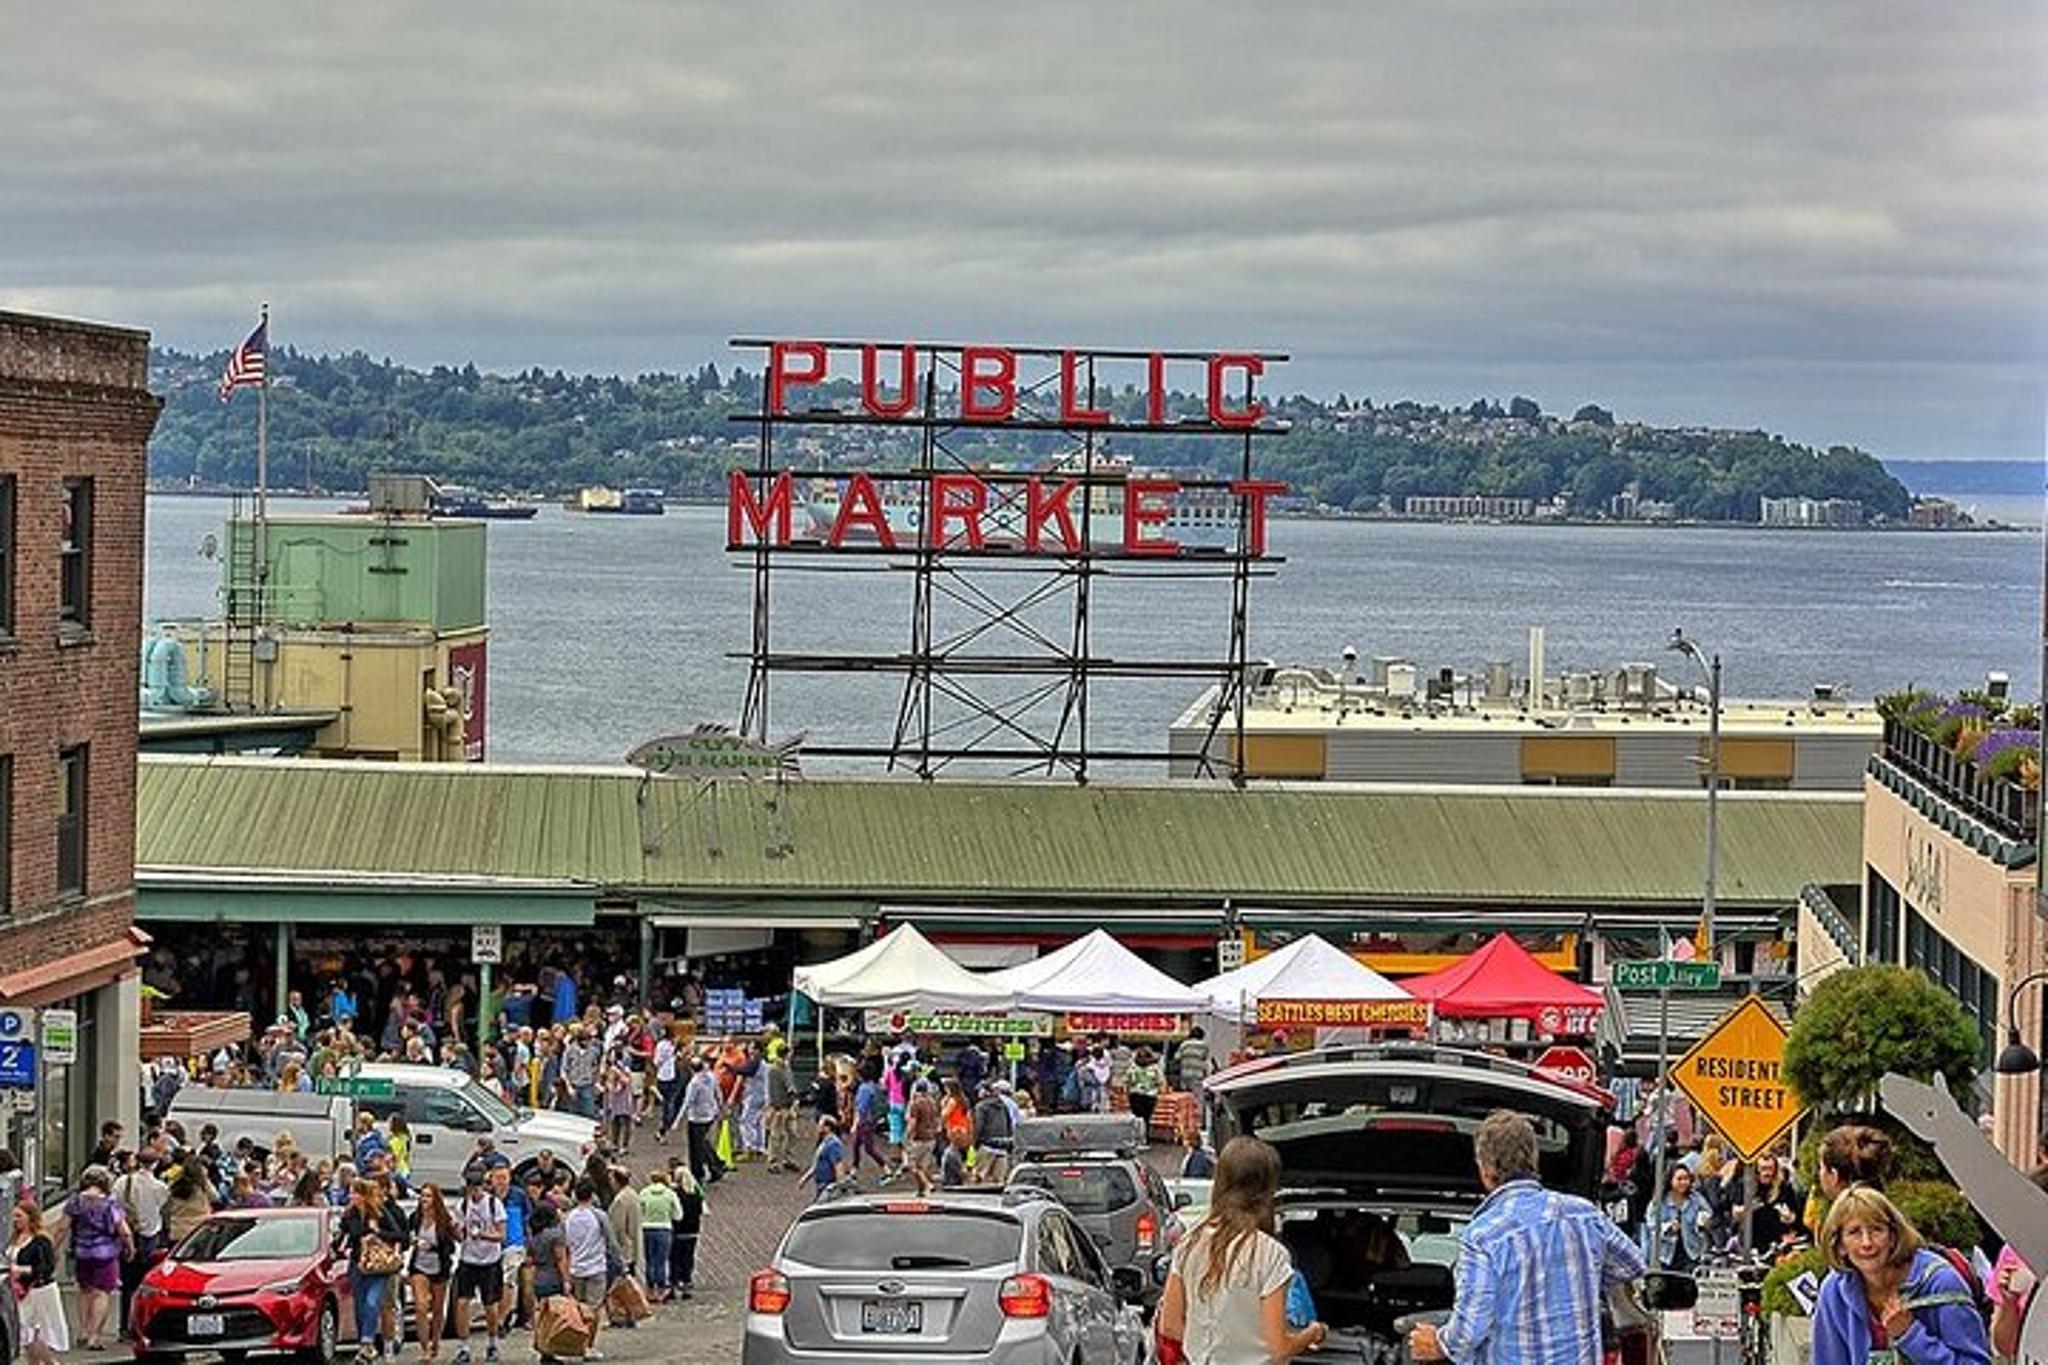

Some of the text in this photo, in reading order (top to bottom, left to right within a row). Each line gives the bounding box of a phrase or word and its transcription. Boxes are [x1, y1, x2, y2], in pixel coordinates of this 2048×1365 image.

[770, 341, 1266, 428] PUBLIC
[728, 469, 1287, 558] MARKET
[1618, 964, 1657, 984] Post
[1068, 1013, 1177, 1031] CHERRIES
[1258, 1003, 1426, 1022] SEATTLES BEST CHERRIES
[3, 1046, 18, 1068] 2
[1719, 1085, 1785, 1110] STREET
